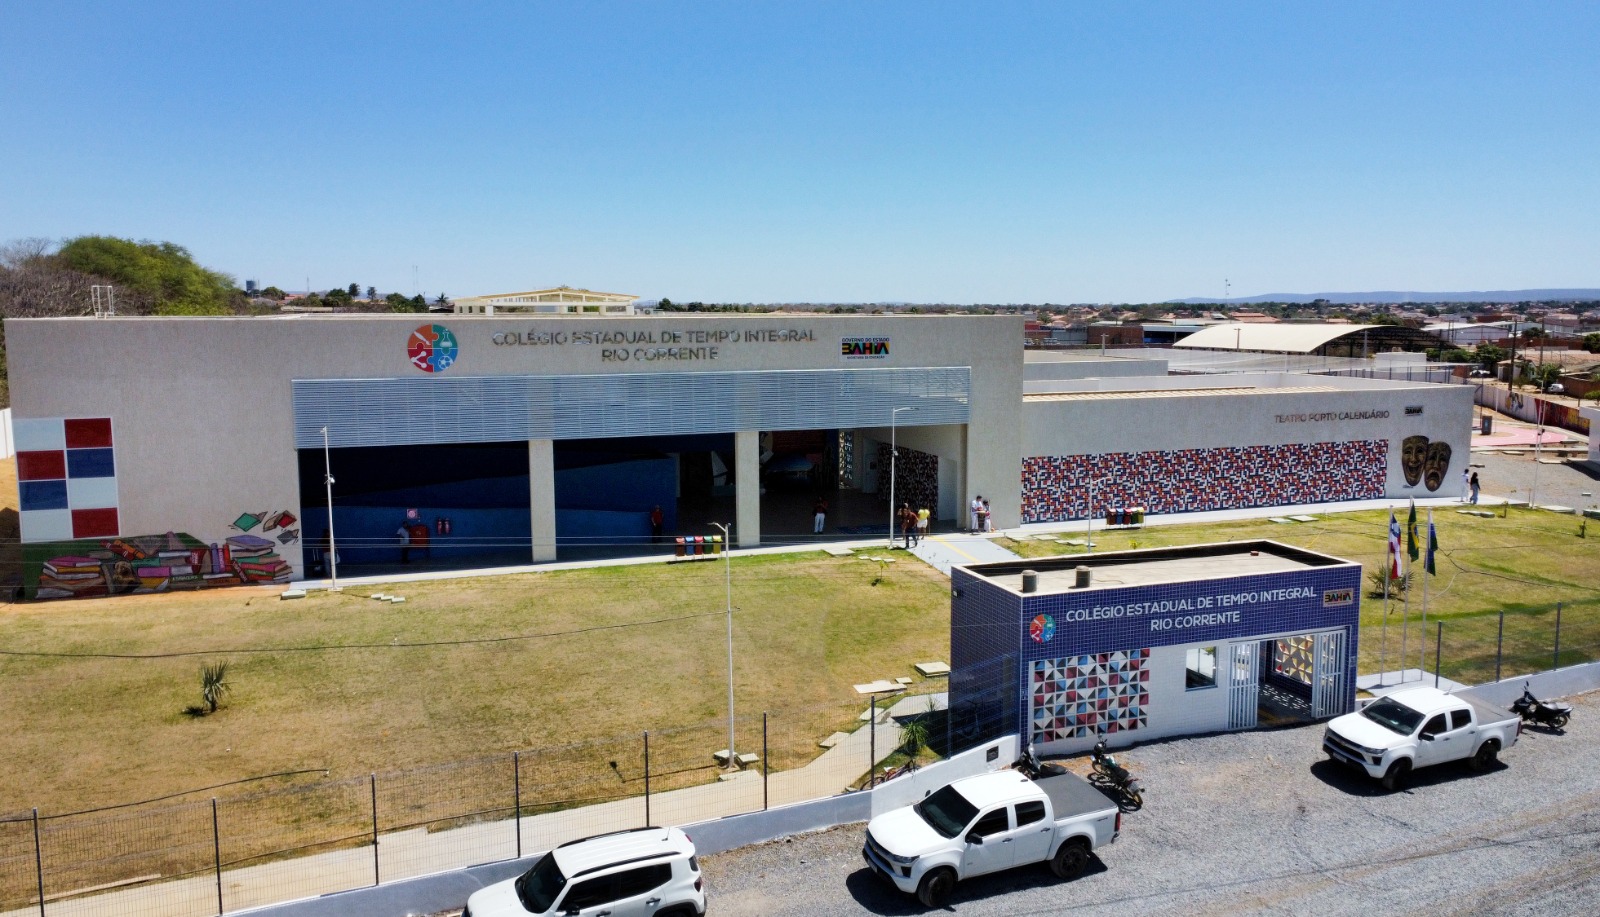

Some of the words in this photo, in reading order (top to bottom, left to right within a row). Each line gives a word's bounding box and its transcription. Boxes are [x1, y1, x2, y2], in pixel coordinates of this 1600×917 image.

[492, 329, 568, 346] COLÉGIO
[572, 331, 656, 345] ESTADUAL
[661, 331, 682, 344] DE
[685, 330, 741, 344] TEMPO
[744, 329, 817, 343] INTEGRAL
[602, 348, 630, 362] RIO
[633, 347, 719, 362] CORRENTE
[842, 342, 890, 355] BAHIA
[1275, 414, 1306, 423] TEATRO
[1308, 413, 1337, 422] PORTO
[1338, 409, 1390, 420] CALENDÁRIO
[1066, 605, 1124, 621] COLÉGIO
[1126, 599, 1195, 616] ESTADUAL
[1197, 596, 1214, 609] DE
[1216, 592, 1258, 607] TEMPO
[1260, 586, 1318, 602] INTEGRAL
[1324, 592, 1352, 602] BAHIA
[1150, 618, 1173, 632] RIO
[1174, 611, 1240, 628] CORRENTE
